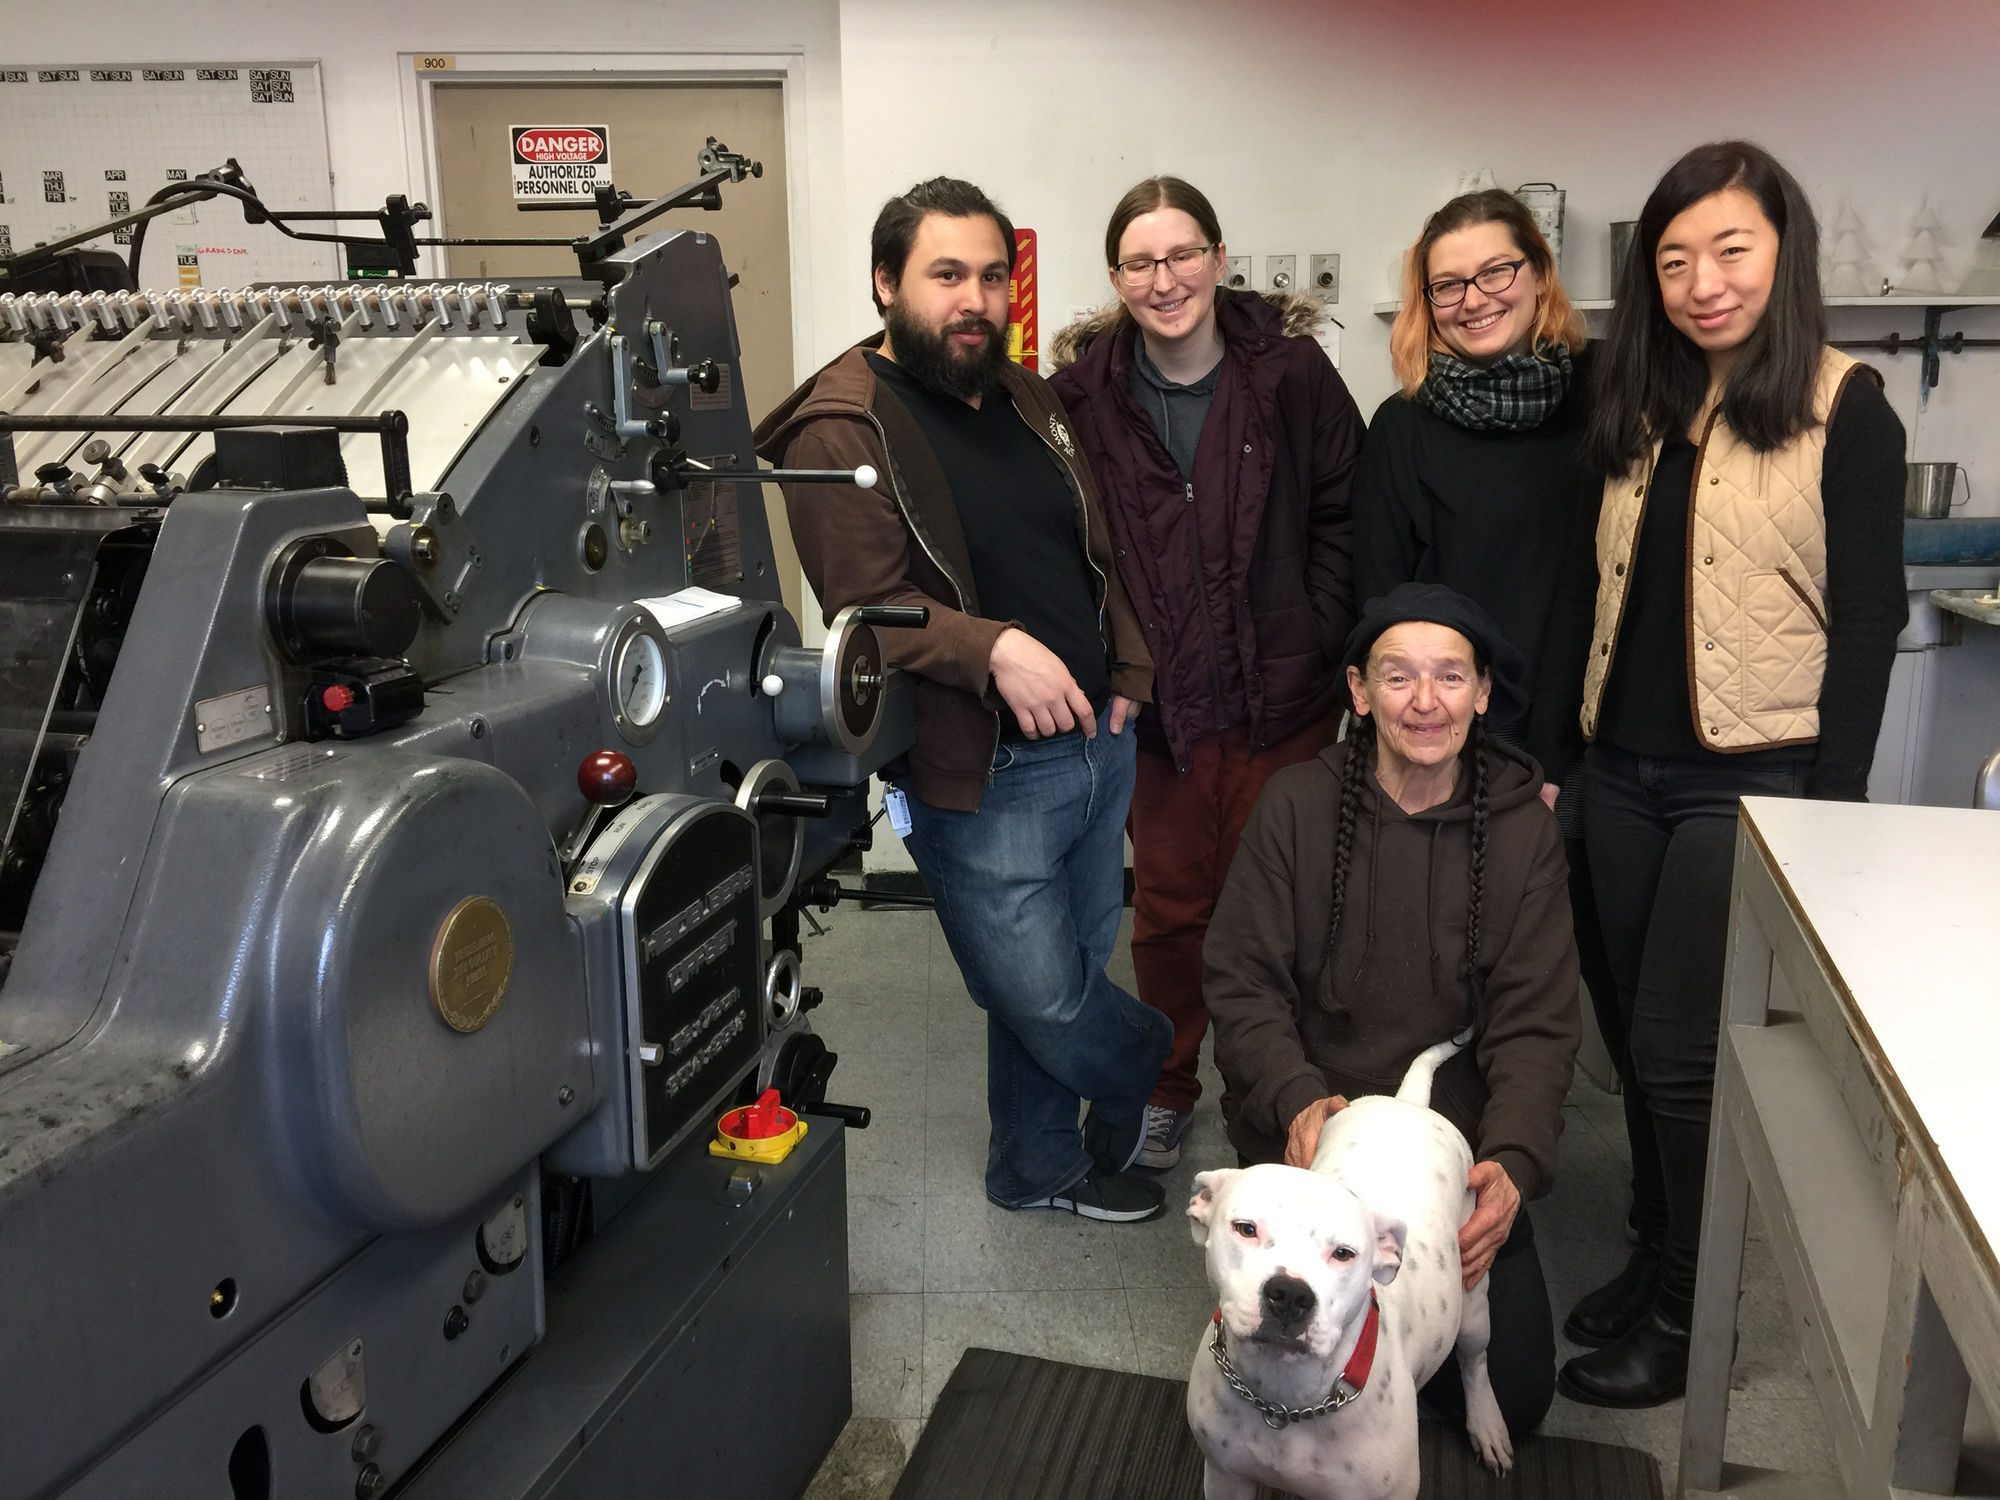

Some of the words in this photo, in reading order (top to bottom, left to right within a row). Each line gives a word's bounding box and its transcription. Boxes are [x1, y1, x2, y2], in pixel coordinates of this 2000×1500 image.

[424, 58, 445, 69] 900
[7, 71, 28, 82] SUN
[39, 72, 58, 82] SAT
[59, 71, 79, 81] SUN
[91, 71, 110, 81] SAT
[111, 71, 131, 81] SUN
[143, 71, 162, 80] SAT
[163, 70, 183, 80] SUN
[197, 70, 216, 80] SAT
[217, 70, 237, 80] SUN
[250, 71, 269, 81] SAT
[270, 70, 290, 80] SUN
[251, 81, 270, 91] SAT
[272, 81, 292, 91] SUN
[252, 92, 271, 102] SAT
[274, 92, 294, 102] SUN
[521, 136, 600, 152] DANGER
[536, 152, 554, 160] HIGH
[556, 152, 587, 160] VOLTAGE
[43, 171, 62, 180] MAR
[106, 170, 125, 180] APR
[167, 170, 186, 179] MAY
[529, 165, 596, 179] AUTHORIZED
[45, 182, 64, 191] THU
[517, 180, 579, 194] PERSONNEL
[581, 180, 610, 194] ON
[47, 192, 62, 202] FRI
[108, 192, 128, 201] MON
[110, 202, 129, 212] TUE
[116, 235, 131, 244] FRI
[179, 256, 198, 265] TUE
[585, 856, 600, 875] STOP
